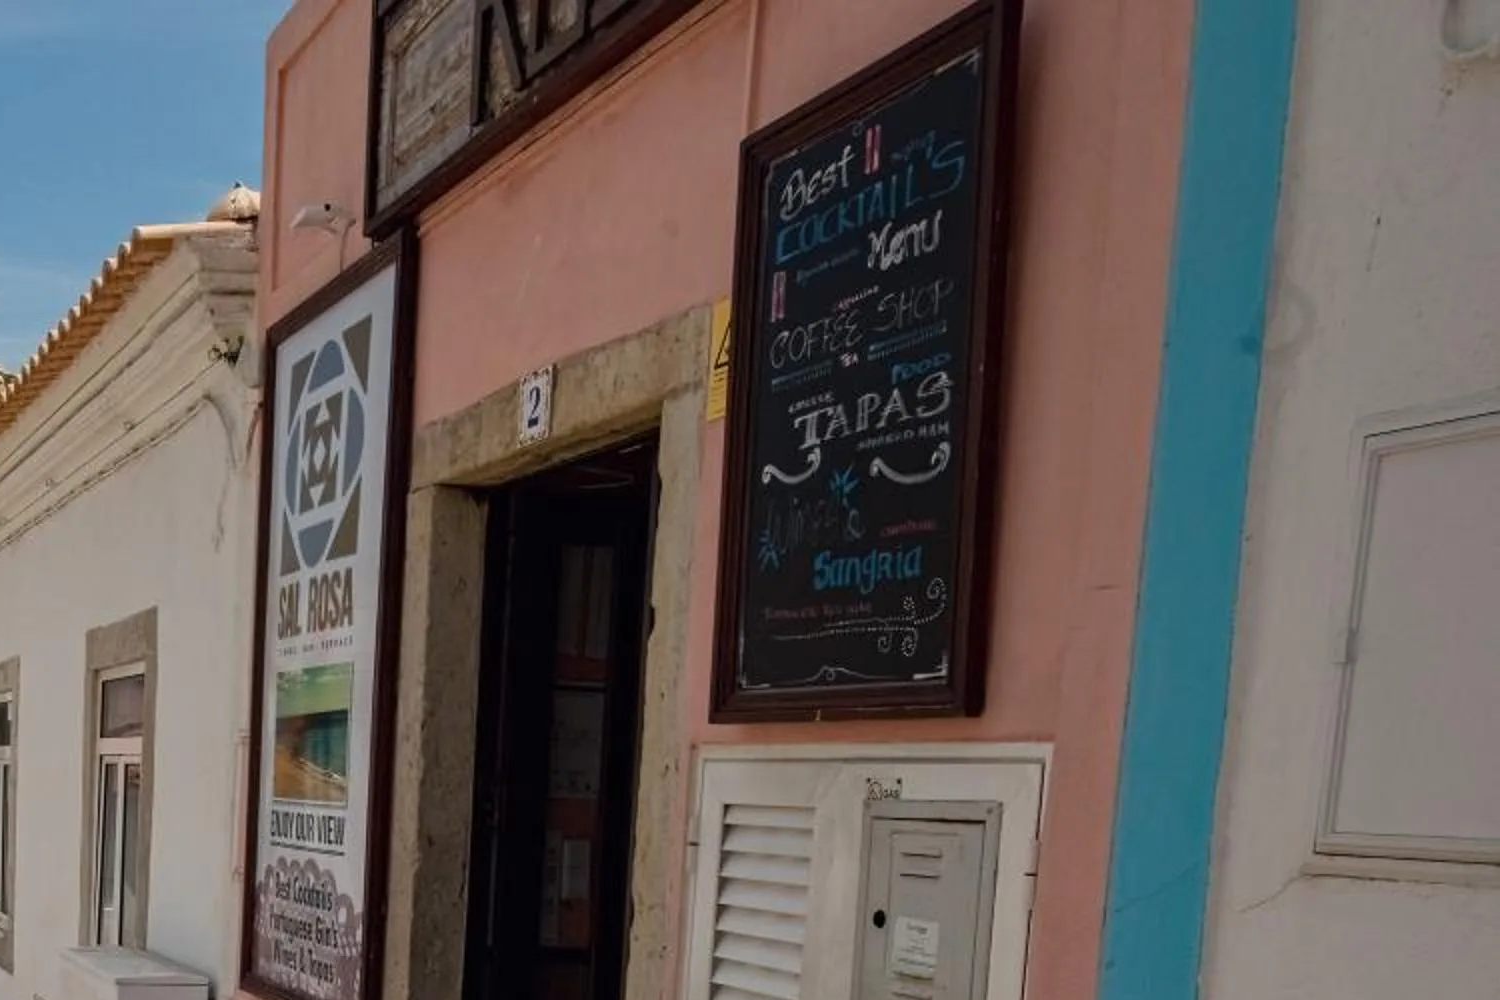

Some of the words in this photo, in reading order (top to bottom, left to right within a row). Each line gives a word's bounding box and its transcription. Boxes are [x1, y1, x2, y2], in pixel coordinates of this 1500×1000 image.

[779, 144, 857, 221] Best
[527, 386, 541, 428] 2
[793, 370, 954, 450] TAPAS
[277, 579, 302, 640] SAL
[307, 566, 353, 633] ROSA
